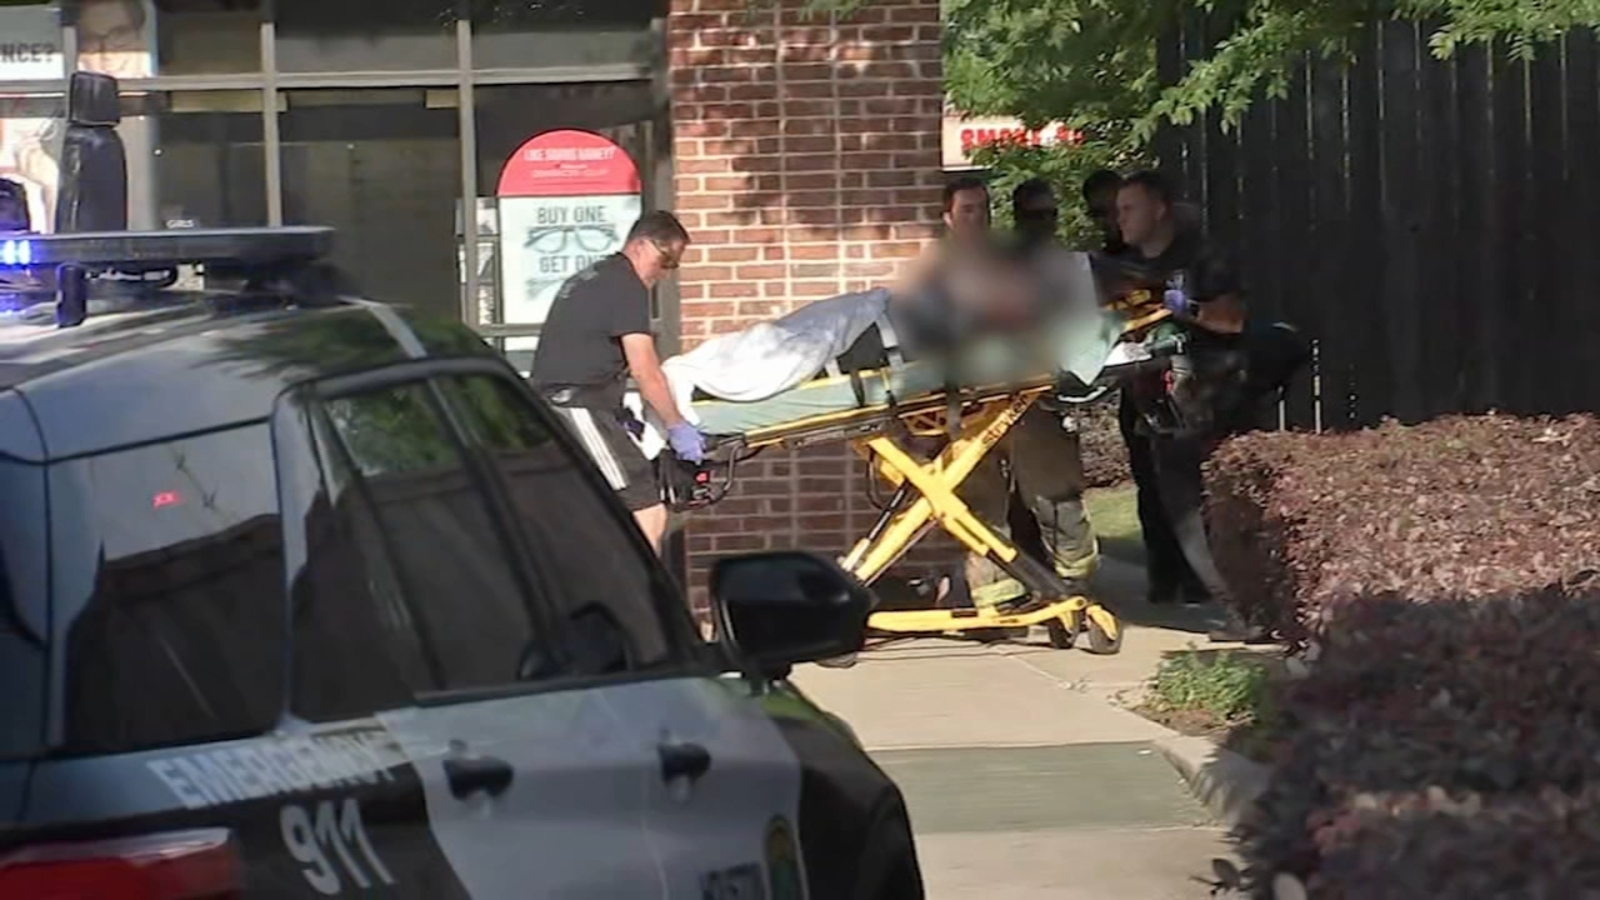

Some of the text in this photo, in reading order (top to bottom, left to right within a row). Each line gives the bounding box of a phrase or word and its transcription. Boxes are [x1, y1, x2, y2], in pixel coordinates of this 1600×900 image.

[538, 205, 608, 224] BUY ONE
[539, 254, 570, 273] GET
[146, 730, 396, 810] EMERGENCY
[280, 798, 395, 895] 911
